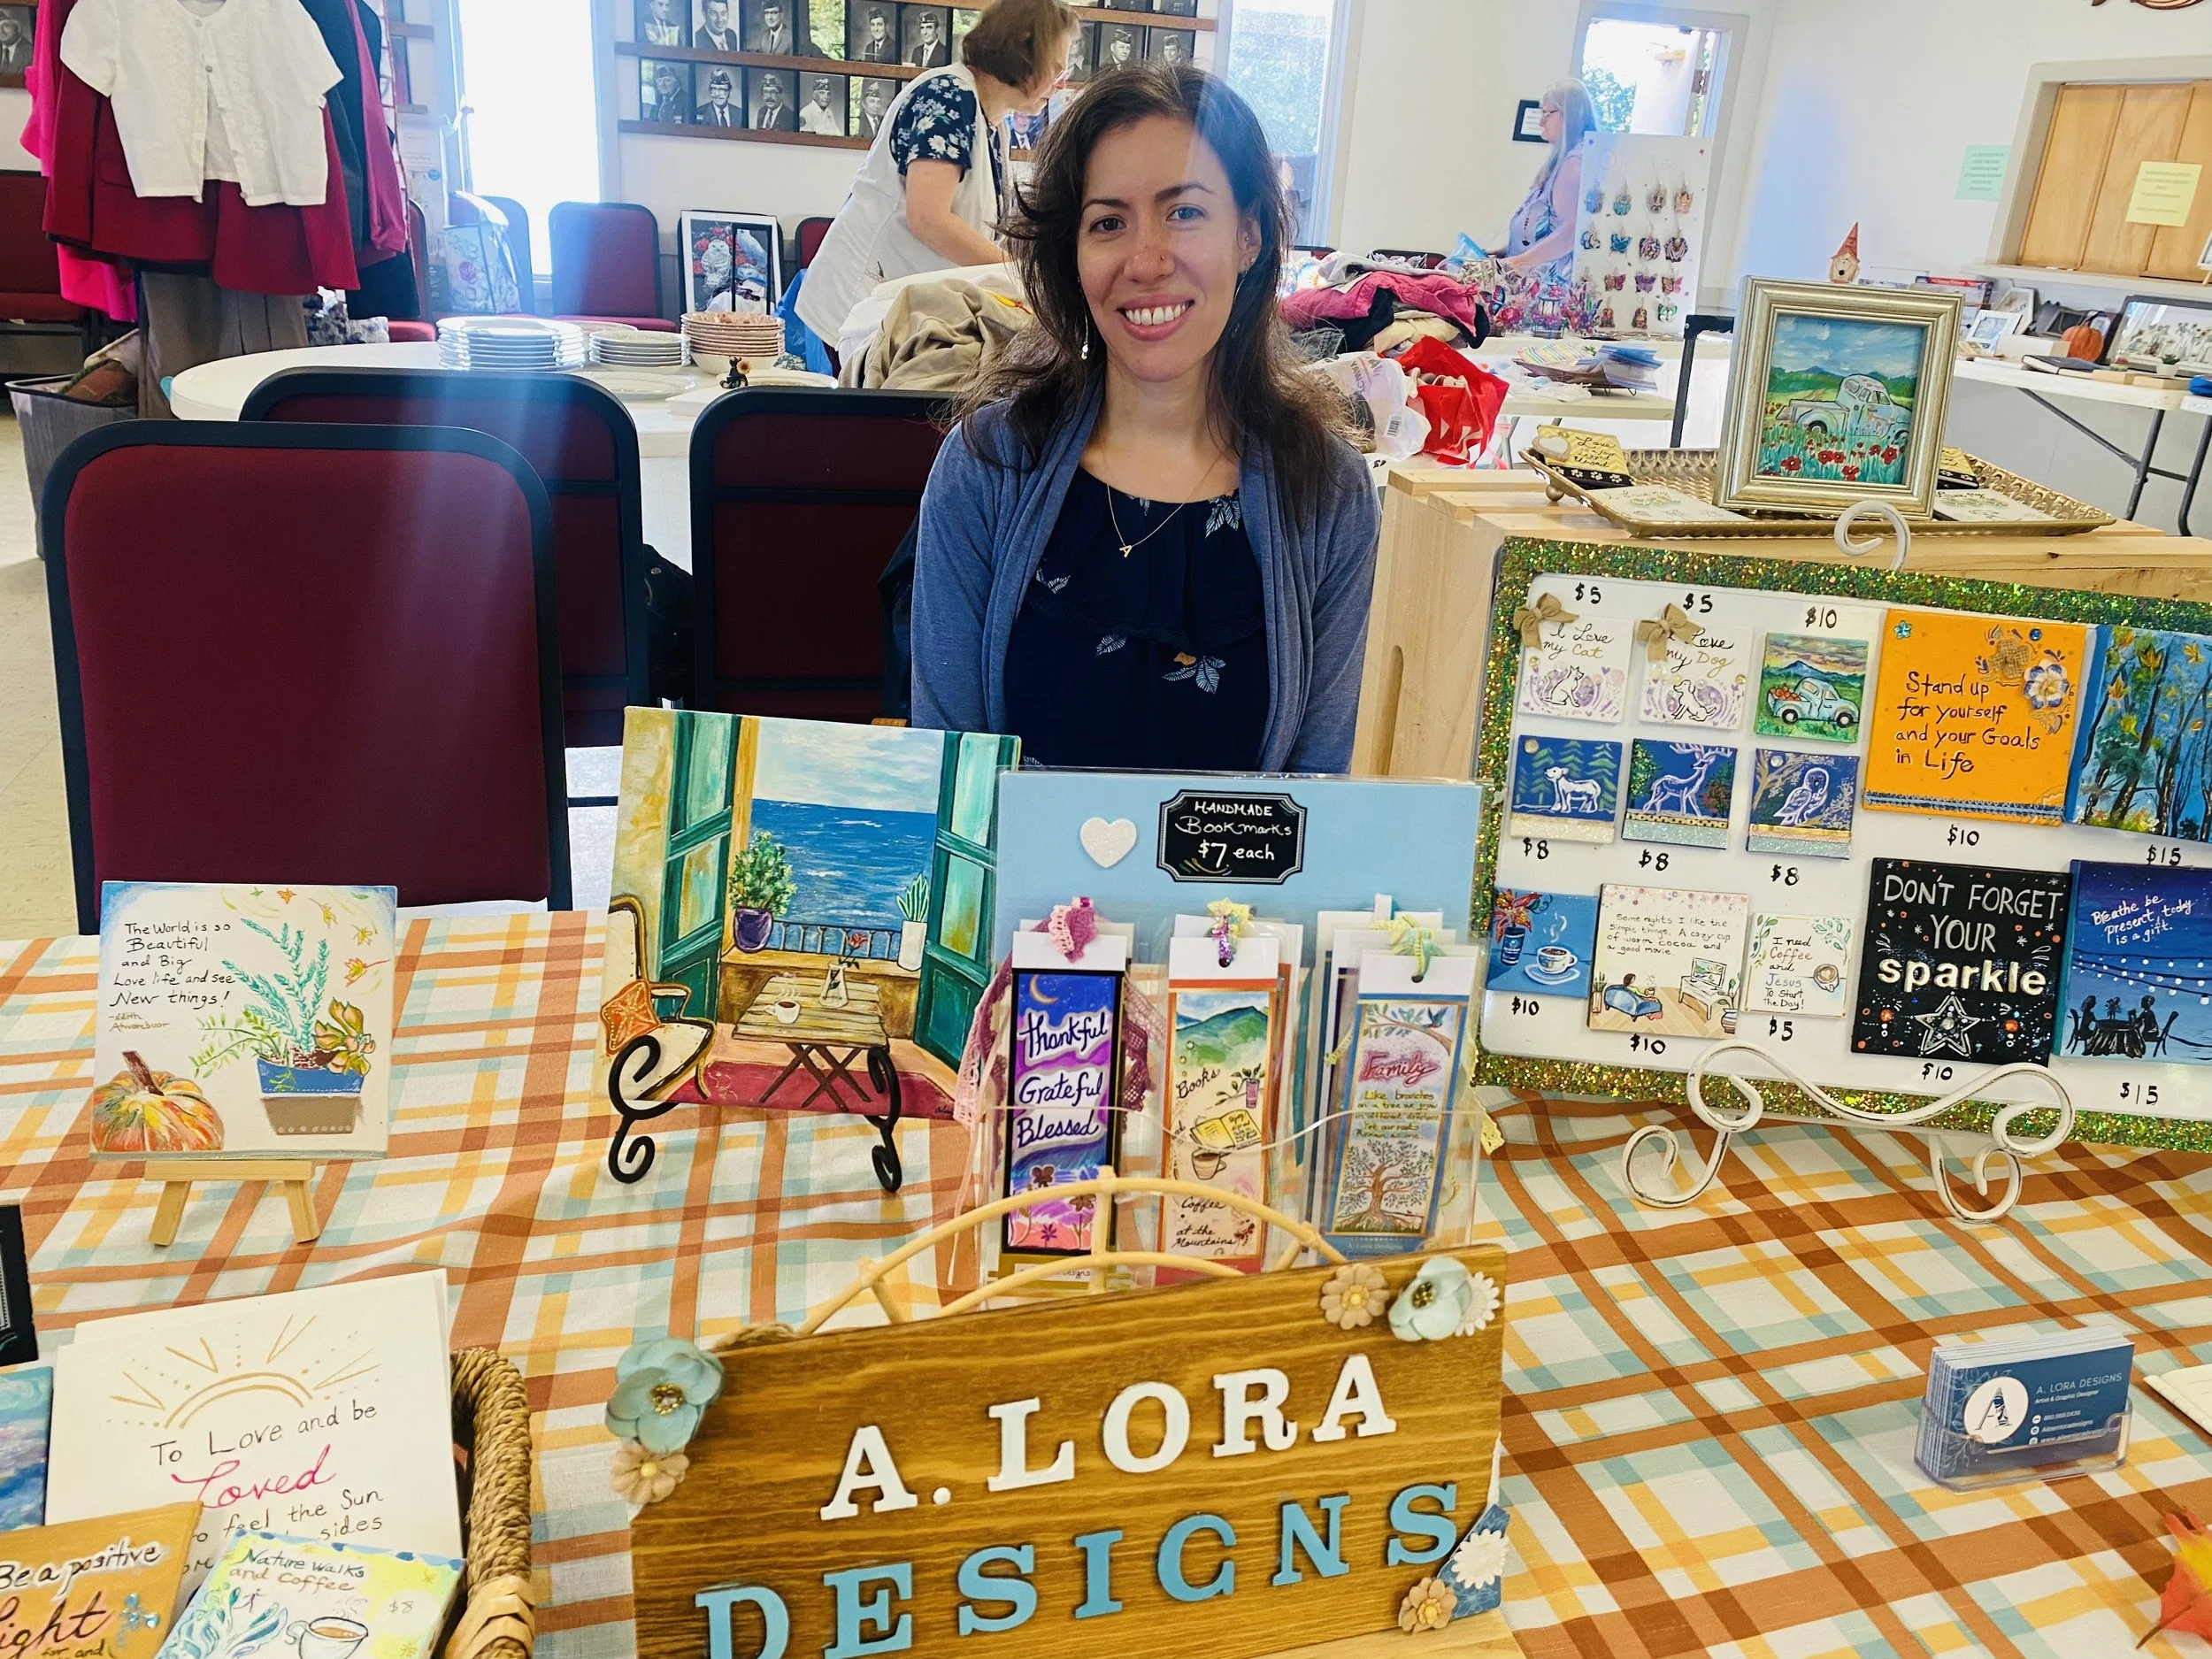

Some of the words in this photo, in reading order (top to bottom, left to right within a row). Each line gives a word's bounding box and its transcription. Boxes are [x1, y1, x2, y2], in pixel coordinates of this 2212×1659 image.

[1575, 436, 1616, 449] Love
[1574, 581, 1601, 605] $5
[1682, 592, 1713, 614] $5
[1805, 606, 1838, 629] $10
[1572, 623, 1615, 644] Love
[1543, 640, 1567, 661] my
[1571, 643, 1604, 659] Cat
[1666, 649, 1693, 672] my
[1697, 650, 1734, 679] Dog
[1906, 671, 1966, 696] Stand
[1970, 681, 1990, 703] up
[1897, 696, 1930, 720] for
[1936, 704, 2008, 725] yourself
[1895, 723, 1928, 741] and
[1934, 730, 1976, 749] your
[1982, 726, 2040, 749] Goals
[1895, 748, 1911, 764] in
[1924, 749, 1975, 780] Life
[1194, 801, 1273, 817] HANDMADE
[1947, 825, 1980, 846] $10
[1197, 839, 1227, 868] $7
[1233, 843, 1275, 861] each
[1523, 837, 1549, 860] $8
[2146, 844, 2182, 866] $15
[1638, 849, 1670, 872] $8
[1770, 864, 1801, 886] $8
[1883, 874, 1955, 907] DON'T
[1968, 883, 2064, 920] FORGET
[2145, 895, 2164, 907] be
[125, 923, 150, 934] The
[153, 920, 190, 934] World
[195, 922, 207, 932] is
[1644, 915, 1672, 926] nights
[1690, 917, 1706, 926] like
[1710, 917, 1727, 927] the
[2104, 909, 2154, 944] present
[2162, 899, 2195, 916] today
[1607, 932, 1620, 941] of
[1678, 928, 1686, 937] A
[1691, 931, 1714, 941] cozy
[1717, 933, 1731, 943] cup
[1786, 936, 1812, 947] need
[1930, 913, 1997, 953] YOUR
[2116, 934, 2128, 946] is
[126, 937, 208, 953] Beautiful
[1617, 946, 1640, 955] good
[1770, 947, 1812, 964] Coffee
[122, 955, 150, 967] and
[158, 955, 192, 974] Big
[1770, 963, 1794, 972] and
[113, 972, 146, 987] Love
[152, 972, 180, 985] life
[185, 969, 209, 983] and
[211, 973, 235, 984] see
[1765, 973, 1802, 987] Jesus
[1878, 957, 2047, 995] sparkle
[109, 990, 159, 1007] New
[1778, 988, 1803, 998] Start
[1511, 995, 1540, 1016] $10
[1769, 1015, 1793, 1041] $5
[1630, 1034, 1666, 1055] $10
[1361, 1049, 1439, 1086] Family
[1922, 1062, 1953, 1080] $10
[1019, 1071, 1104, 1106] Grateful
[1176, 1067, 1220, 1099] Books
[2119, 1082, 2159, 1105] $15
[1018, 1109, 1099, 1148] Blessed
[1181, 1195, 1225, 1213] Coffee
[1176, 1225, 1193, 1235] at
[1192, 1225, 1215, 1235] the
[1171, 1237, 1238, 1248] Mountains
[2036, 1386, 2046, 1394] A.
[2050, 1380, 2077, 1393] LORA
[2078, 1372, 2123, 1388] DESIGNS
[150, 1440, 182, 1465] To
[209, 1424, 282, 1455] Love
[297, 1407, 339, 1434] and
[353, 1399, 378, 1421] be
[171, 1443, 336, 1509] Loved
[288, 1503, 327, 1523] the
[341, 1489, 383, 1509] Sun
[320, 1516, 383, 1541] sides
[38, 1567, 59, 1582] a
[58, 1539, 162, 1595] positive
[231, 1548, 305, 1571] Nature
[230, 1567, 269, 1580] and
[388, 1600, 414, 1614] $8
[74, 1639, 105, 1657] and
